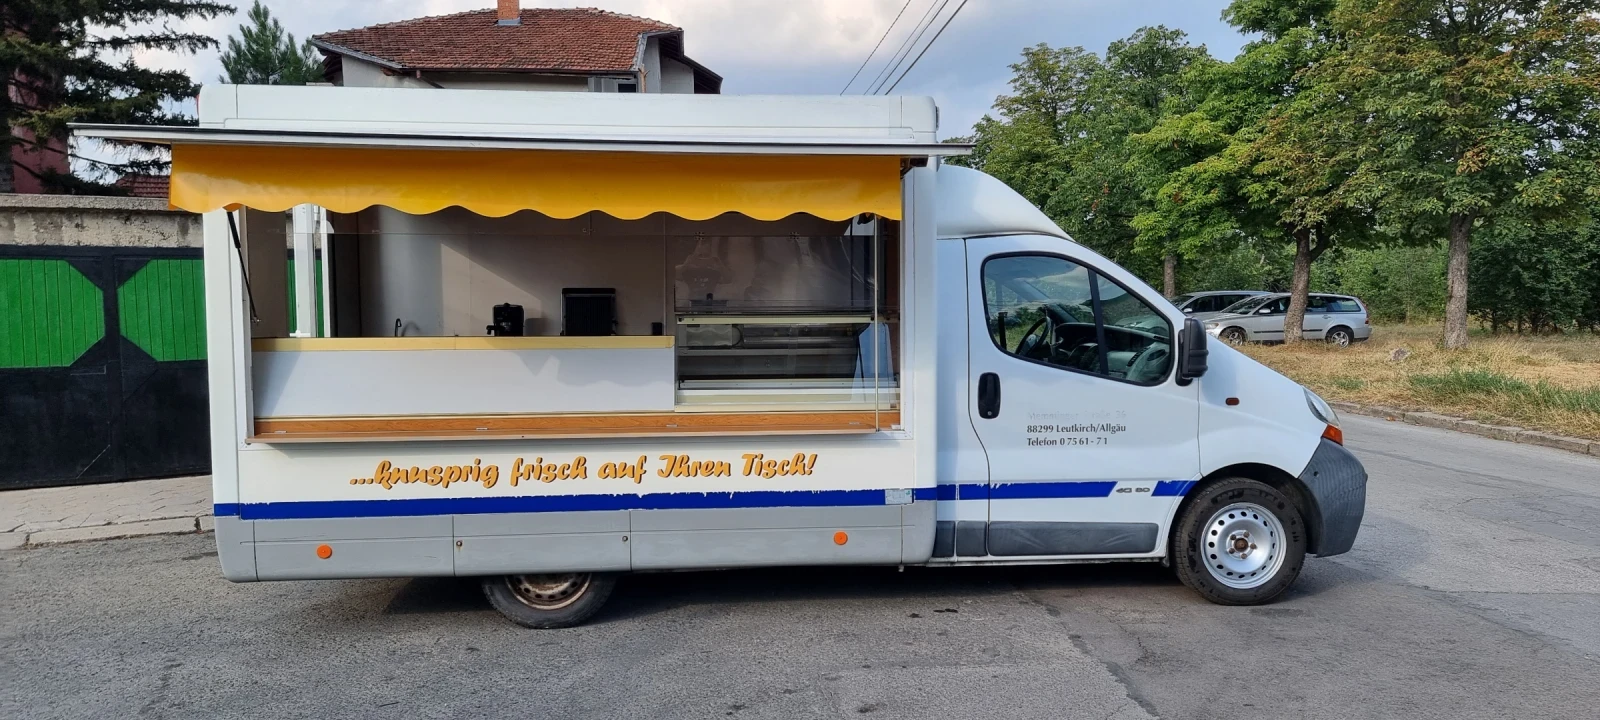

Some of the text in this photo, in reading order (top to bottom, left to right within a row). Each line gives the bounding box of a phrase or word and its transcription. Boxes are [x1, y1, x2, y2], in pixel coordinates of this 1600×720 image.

[1026, 423, 1126, 435] 88299 Leutkirch/Allgäu
[1026, 437, 1057, 447] Telefon
[349, 452, 818, 490] ...knusprig frisch auf Ihren Tisch!
